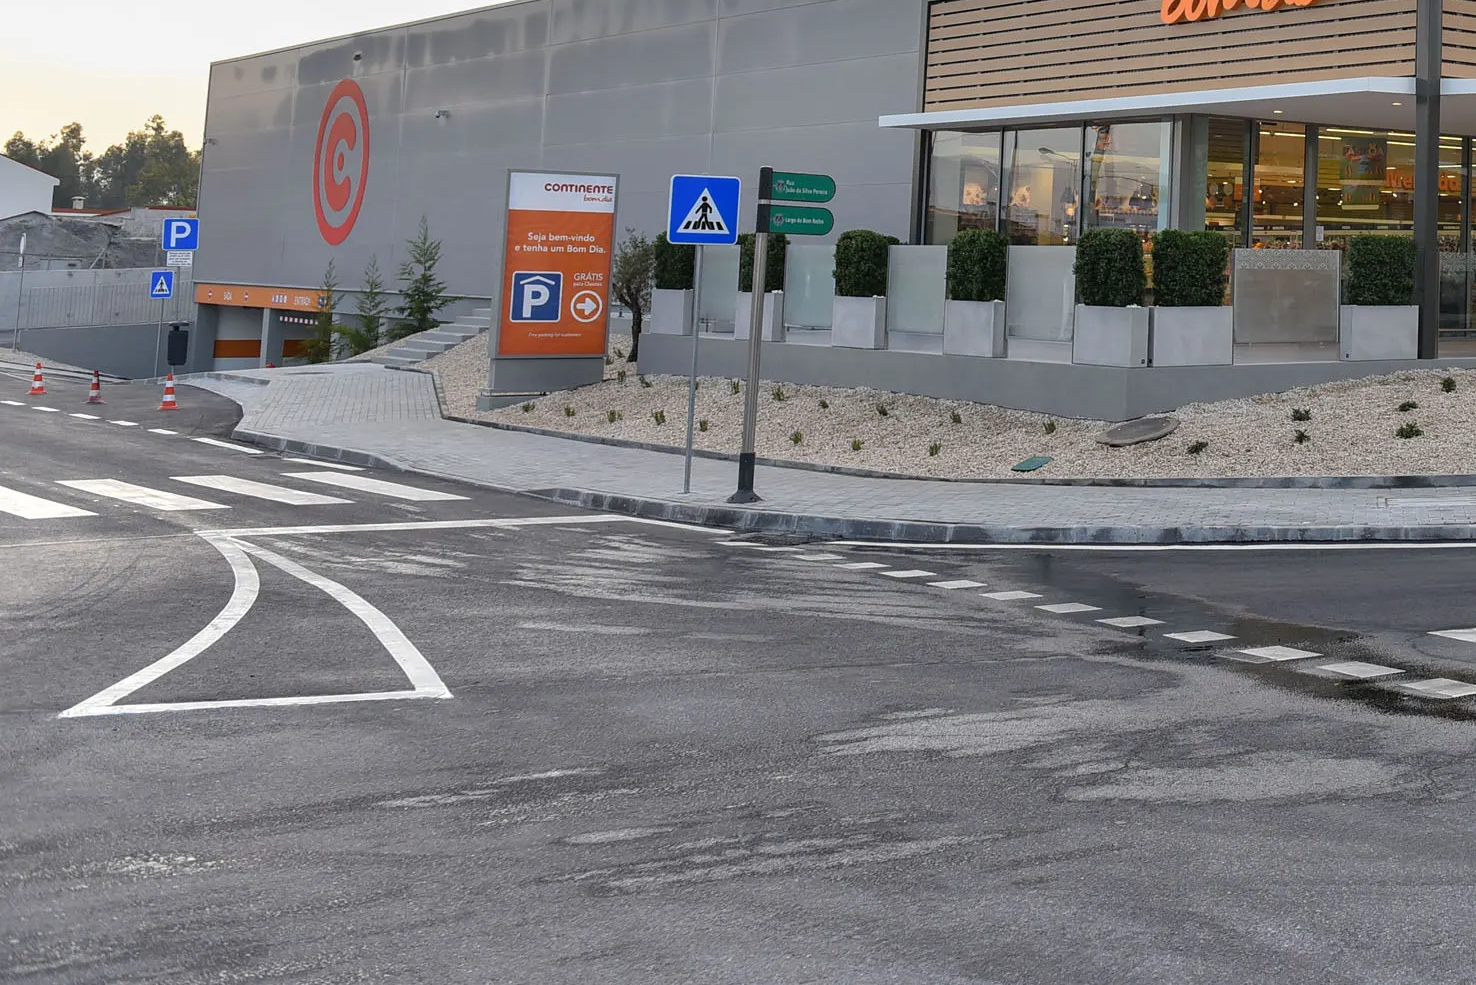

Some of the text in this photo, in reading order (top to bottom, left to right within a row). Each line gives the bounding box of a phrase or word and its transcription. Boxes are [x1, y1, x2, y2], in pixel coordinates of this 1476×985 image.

[544, 183, 614, 194] CONTINENTE
[527, 232, 595, 243] Seja bem-vindo
[523, 244, 548, 252] tenha
[566, 245, 587, 253] Bom
[589, 245, 606, 253] Dia.
[573, 271, 604, 281] GRÁTIS
